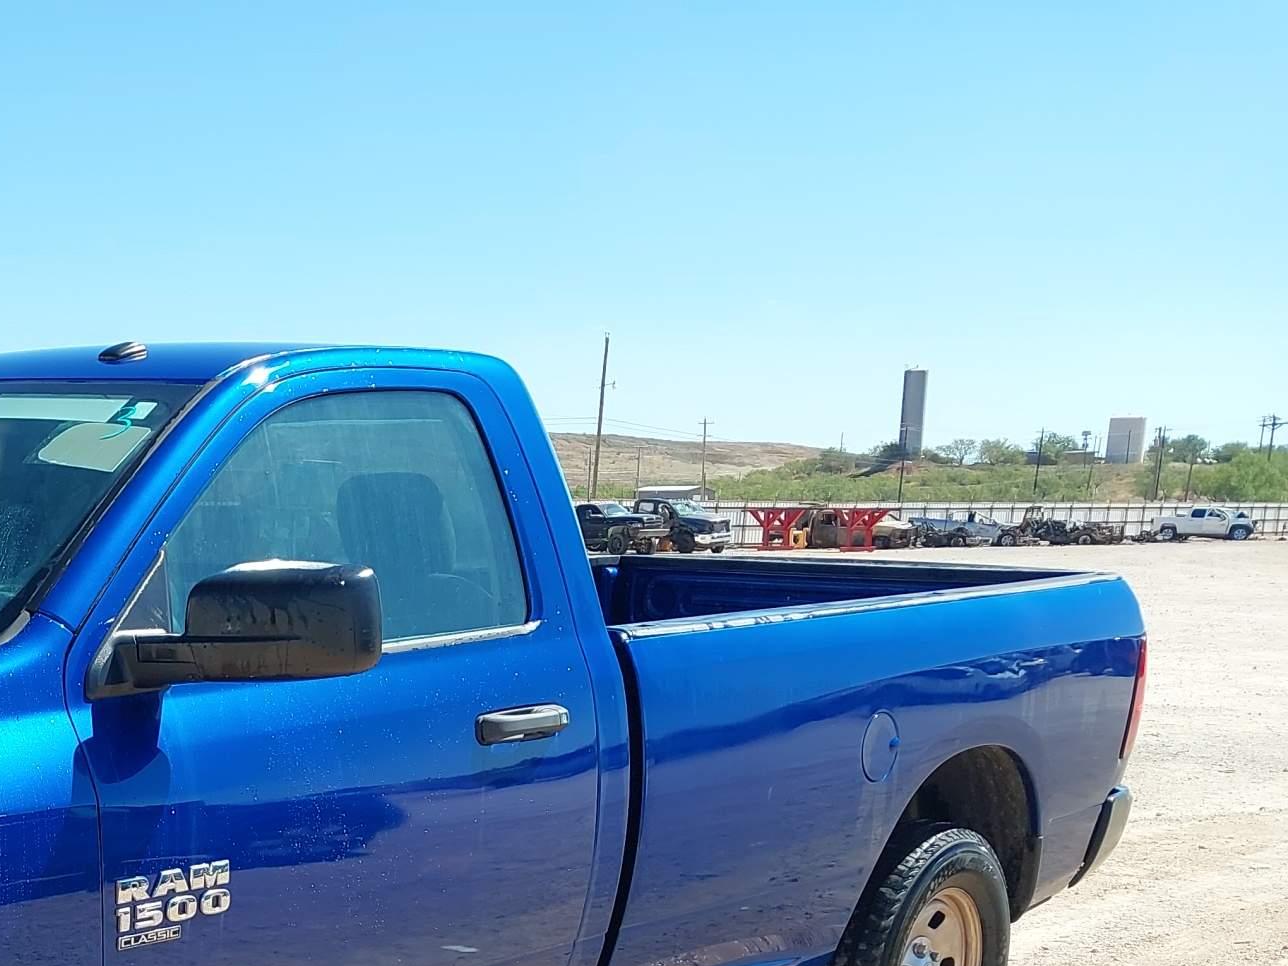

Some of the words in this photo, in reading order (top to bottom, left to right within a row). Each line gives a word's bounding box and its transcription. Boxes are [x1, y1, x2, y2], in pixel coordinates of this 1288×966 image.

[116, 859, 230, 905] RAM
[116, 888, 231, 933] 1500
[121, 928, 179, 948] CLASSIC
